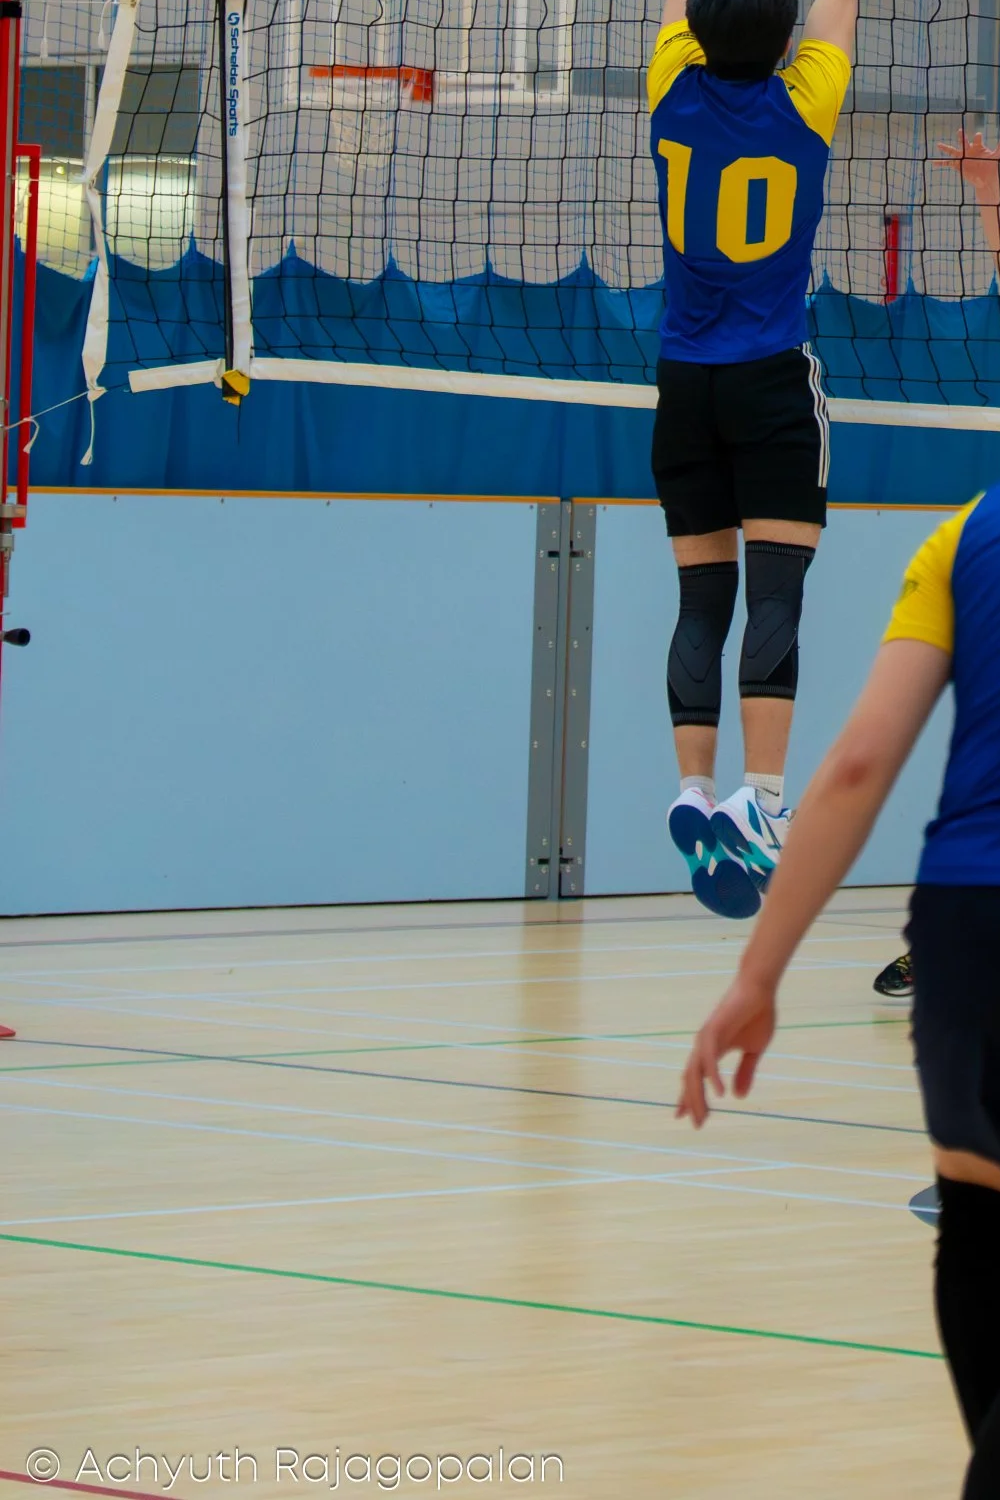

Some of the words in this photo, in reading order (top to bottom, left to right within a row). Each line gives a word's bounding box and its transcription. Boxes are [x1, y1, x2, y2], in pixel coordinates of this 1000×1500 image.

[229, 27, 239, 86] Schelde
[226, 88, 239, 137] Sports
[657, 138, 798, 263] 10
